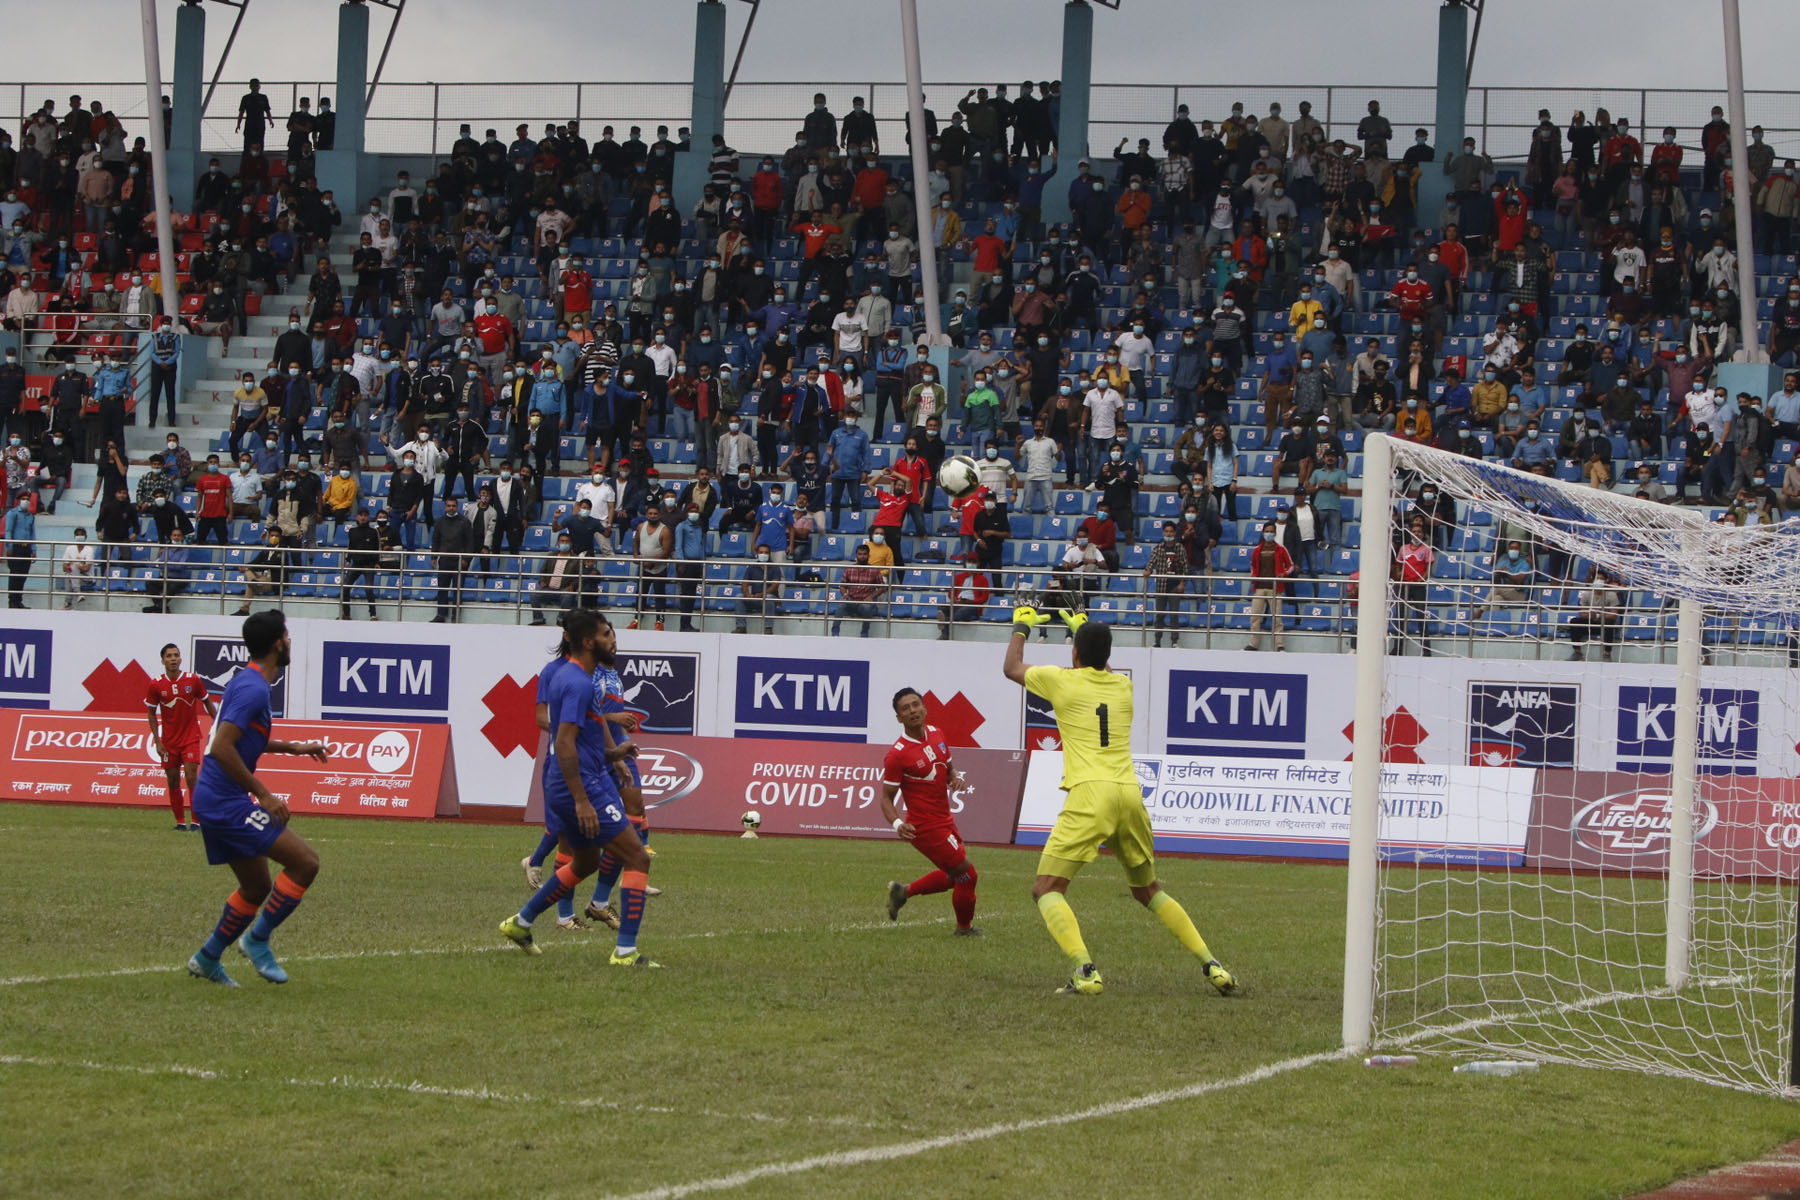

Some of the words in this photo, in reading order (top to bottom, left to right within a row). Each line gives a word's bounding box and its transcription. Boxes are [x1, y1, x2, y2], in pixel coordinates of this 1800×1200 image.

[24, 386, 43, 399] XIT
[212, 391, 220, 402] K
[192, 414, 200, 425] L
[0, 643, 36, 679] M
[216, 644, 252, 662] ANF
[338, 656, 433, 696] KTM
[623, 659, 674, 678] ANFA
[171, 683, 179, 695] 6
[752, 672, 852, 713] KTM
[1185, 685, 1289, 728] KTM
[1496, 689, 1552, 710] ANFA
[1094, 702, 1110, 747] 1
[1636, 702, 1740, 744] KM
[371, 744, 405, 759] PAY
[922, 745, 937, 763] 18
[752, 762, 815, 779] PROVEN
[819, 765, 886, 782] EFFECTIV
[1167, 761, 1216, 782] गुडविल
[1286, 764, 1341, 784] लिमिटेड
[745, 780, 876, 809] COVID-19
[1161, 789, 1267, 813] GOODWILL
[1379, 798, 1444, 819] MITED
[605, 804, 622, 822] 3
[1587, 811, 1698, 830] Lifebu
